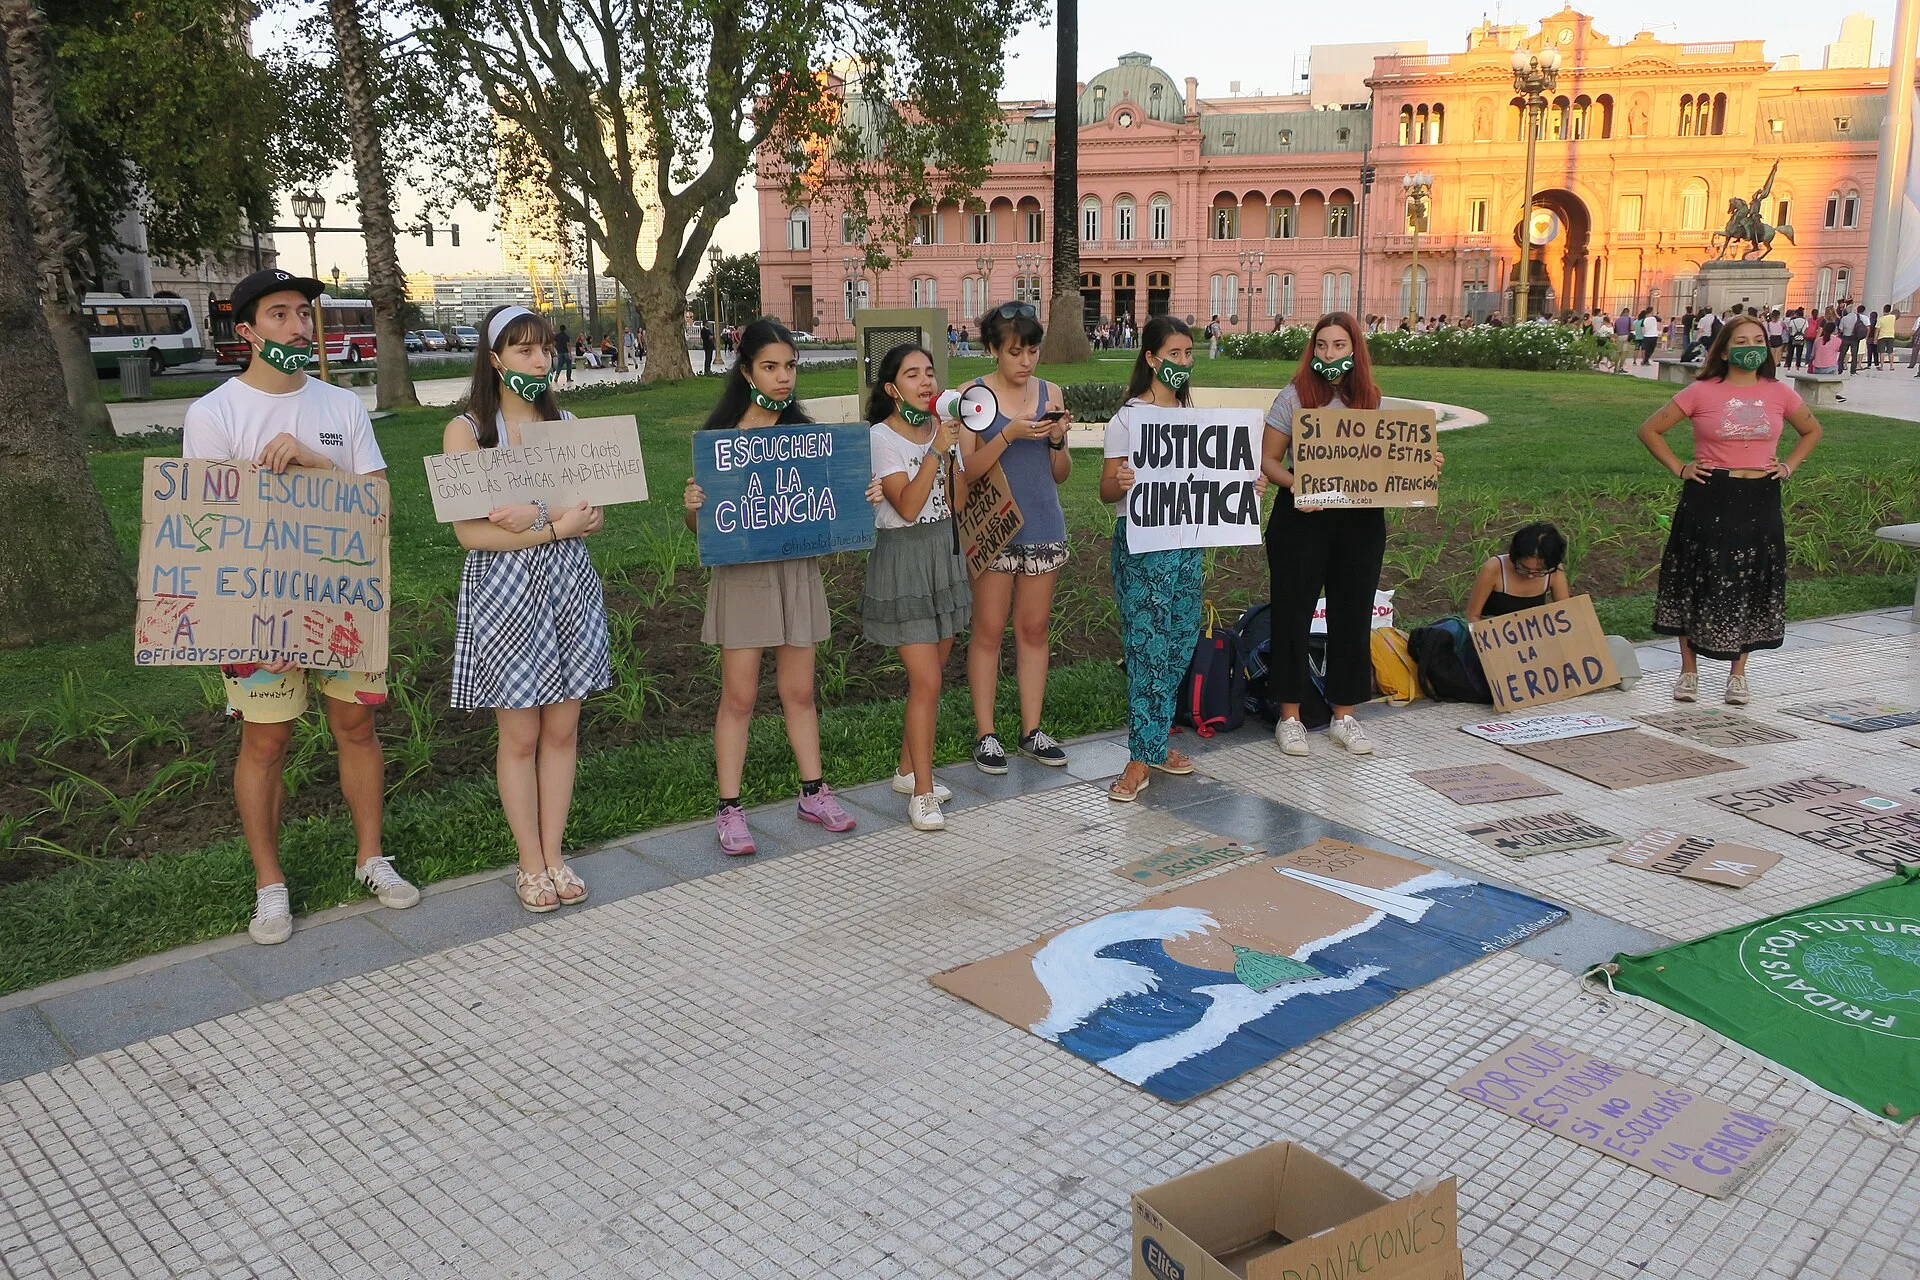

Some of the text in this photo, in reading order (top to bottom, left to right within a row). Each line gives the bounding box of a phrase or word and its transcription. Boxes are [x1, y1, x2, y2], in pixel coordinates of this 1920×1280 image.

[217, 303, 232, 311] 126
[132, 337, 145, 348] 91
[319, 432, 343, 440] SONIC
[320, 439, 345, 447] YOUTH
[1336, 418, 1365, 438] NO
[1375, 419, 1432, 444] ESTAS
[525, 446, 543, 466] ES
[714, 432, 833, 471] ESCUCHEN
[1132, 423, 1255, 471] JUSTICIA
[1387, 443, 1433, 463] ESTAS
[203, 468, 240, 500] NO
[257, 468, 381, 517] ESCUCHAS
[438, 484, 472, 499] COMO
[480, 479, 502, 493] LAS
[748, 467, 802, 497] A LA
[1301, 474, 1378, 494] PRESTANDO
[960, 485, 1002, 536] TIERRA
[1129, 472, 1260, 528] CLIMÁTICA
[155, 513, 366, 560] AL PLANETA
[976, 512, 1001, 546] SI LES
[152, 564, 384, 612] ME ESCUCHARAS
[173, 613, 195, 646] A
[1517, 646, 1538, 663] LA
[1491, 656, 1604, 706] VERDAD
[1477, 723, 1516, 732] 100
[1697, 725, 1798, 746] SANO
[1707, 776, 1857, 812] ESTAMOS
[1805, 801, 1880, 822] EN
[1620, 829, 1680, 863] JUSTICIA
[1157, 847, 1246, 877] DESMONTES
[1317, 854, 1365, 872] 2050
[1702, 860, 1757, 876] YA
[1759, 929, 1811, 957] FOR
[1760, 959, 1896, 1028] FRIDAYS
[1459, 1071, 1528, 1110] POR
[1597, 1097, 1632, 1119] NO
[1651, 1141, 1695, 1174] A LA
[1147, 1243, 1181, 1280] Elite
